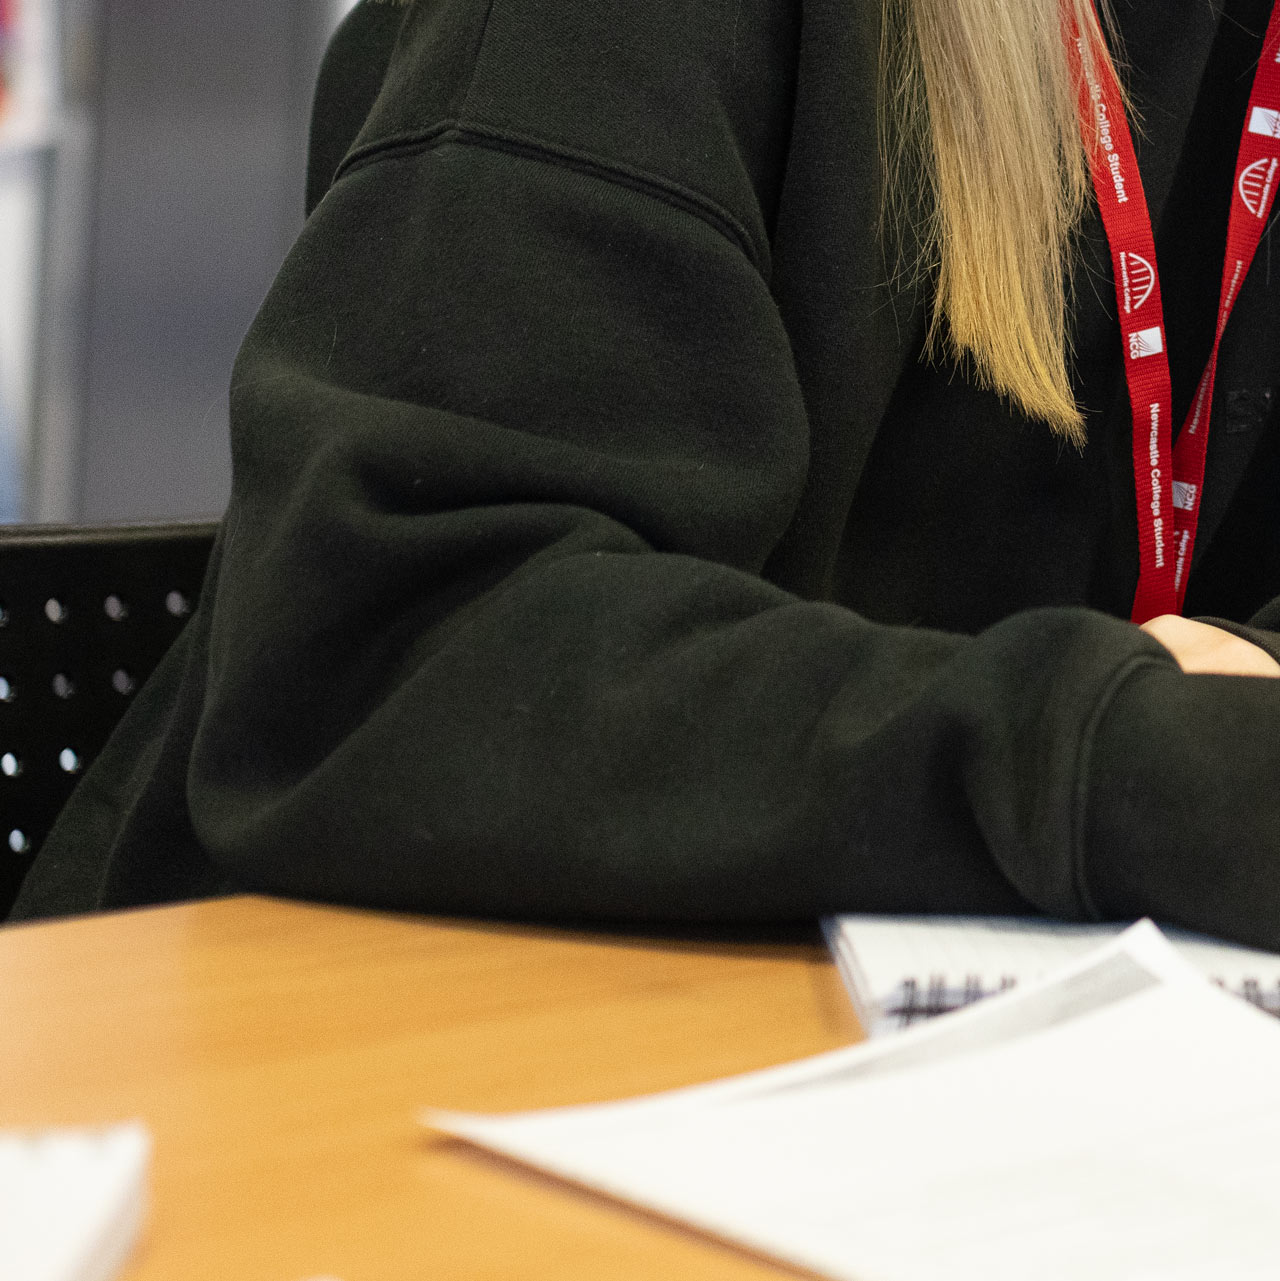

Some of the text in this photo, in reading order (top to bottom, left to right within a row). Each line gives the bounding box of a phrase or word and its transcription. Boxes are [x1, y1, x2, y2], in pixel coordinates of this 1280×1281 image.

[1097, 103, 1129, 204] College Student
[1256, 157, 1279, 218] Newcastle College
[1119, 251, 1132, 314] Newcastle College
[1127, 331, 1140, 360] NCG
[1149, 402, 1165, 568] Newcastle College Student
[1184, 483, 1198, 511] NCG
[1178, 529, 1191, 556] College
